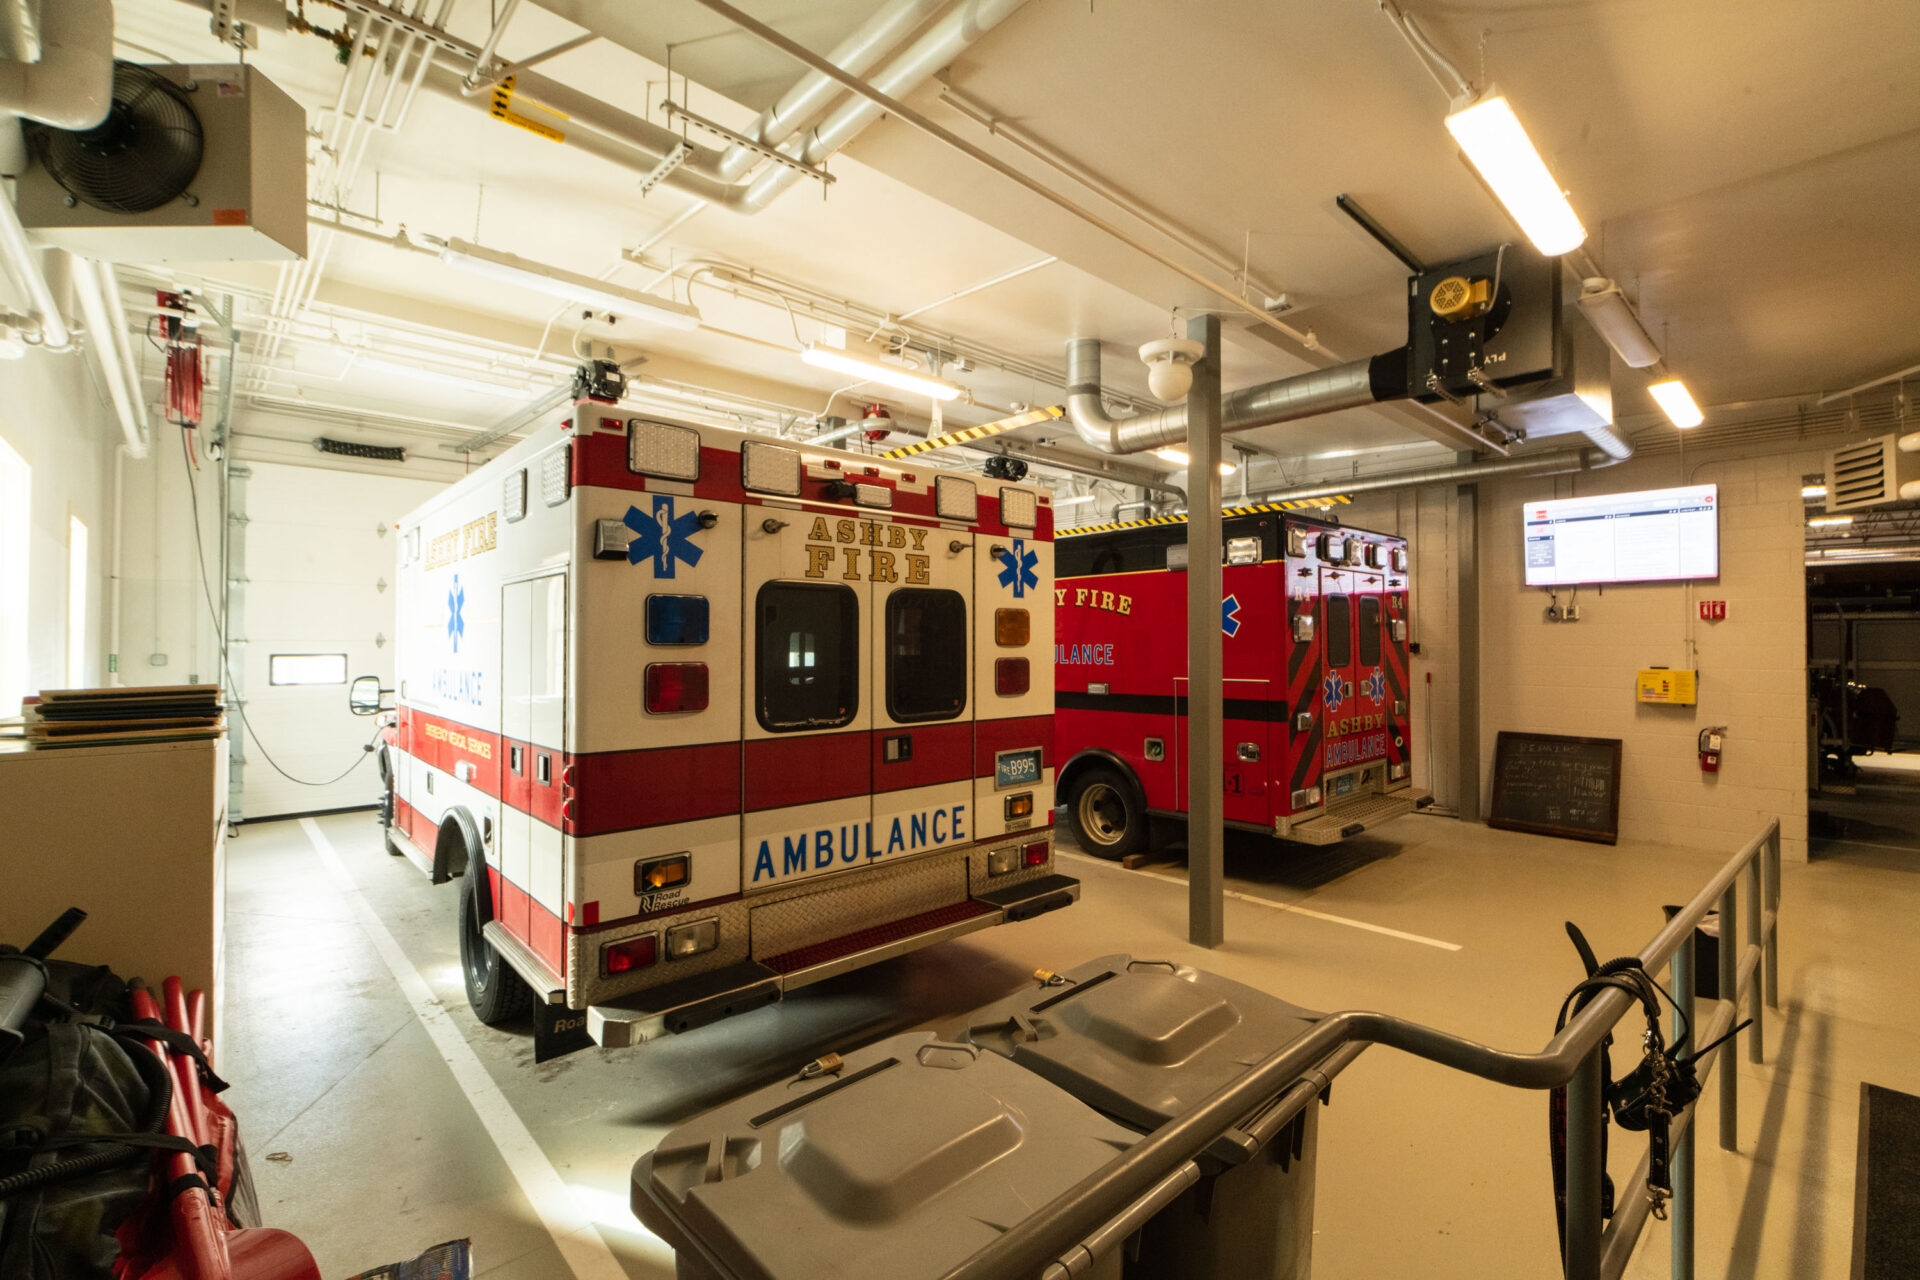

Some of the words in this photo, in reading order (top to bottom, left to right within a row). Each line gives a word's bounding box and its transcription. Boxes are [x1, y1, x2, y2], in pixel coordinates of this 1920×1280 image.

[462, 510, 498, 560] FIRE
[807, 516, 929, 551] ASHBY
[804, 543, 931, 585] FIRE
[1074, 588, 1133, 616] FIRE
[1054, 643, 1115, 665] LANCE
[1327, 713, 1384, 738] ASHBY
[1326, 733, 1385, 769] AMBULANCE
[1010, 757, 1036, 776] B995
[752, 805, 966, 882] AMBULANCE
[654, 897, 690, 911] Rescue
[656, 889, 681, 901] Road
[553, 1016, 586, 1034] Roa
